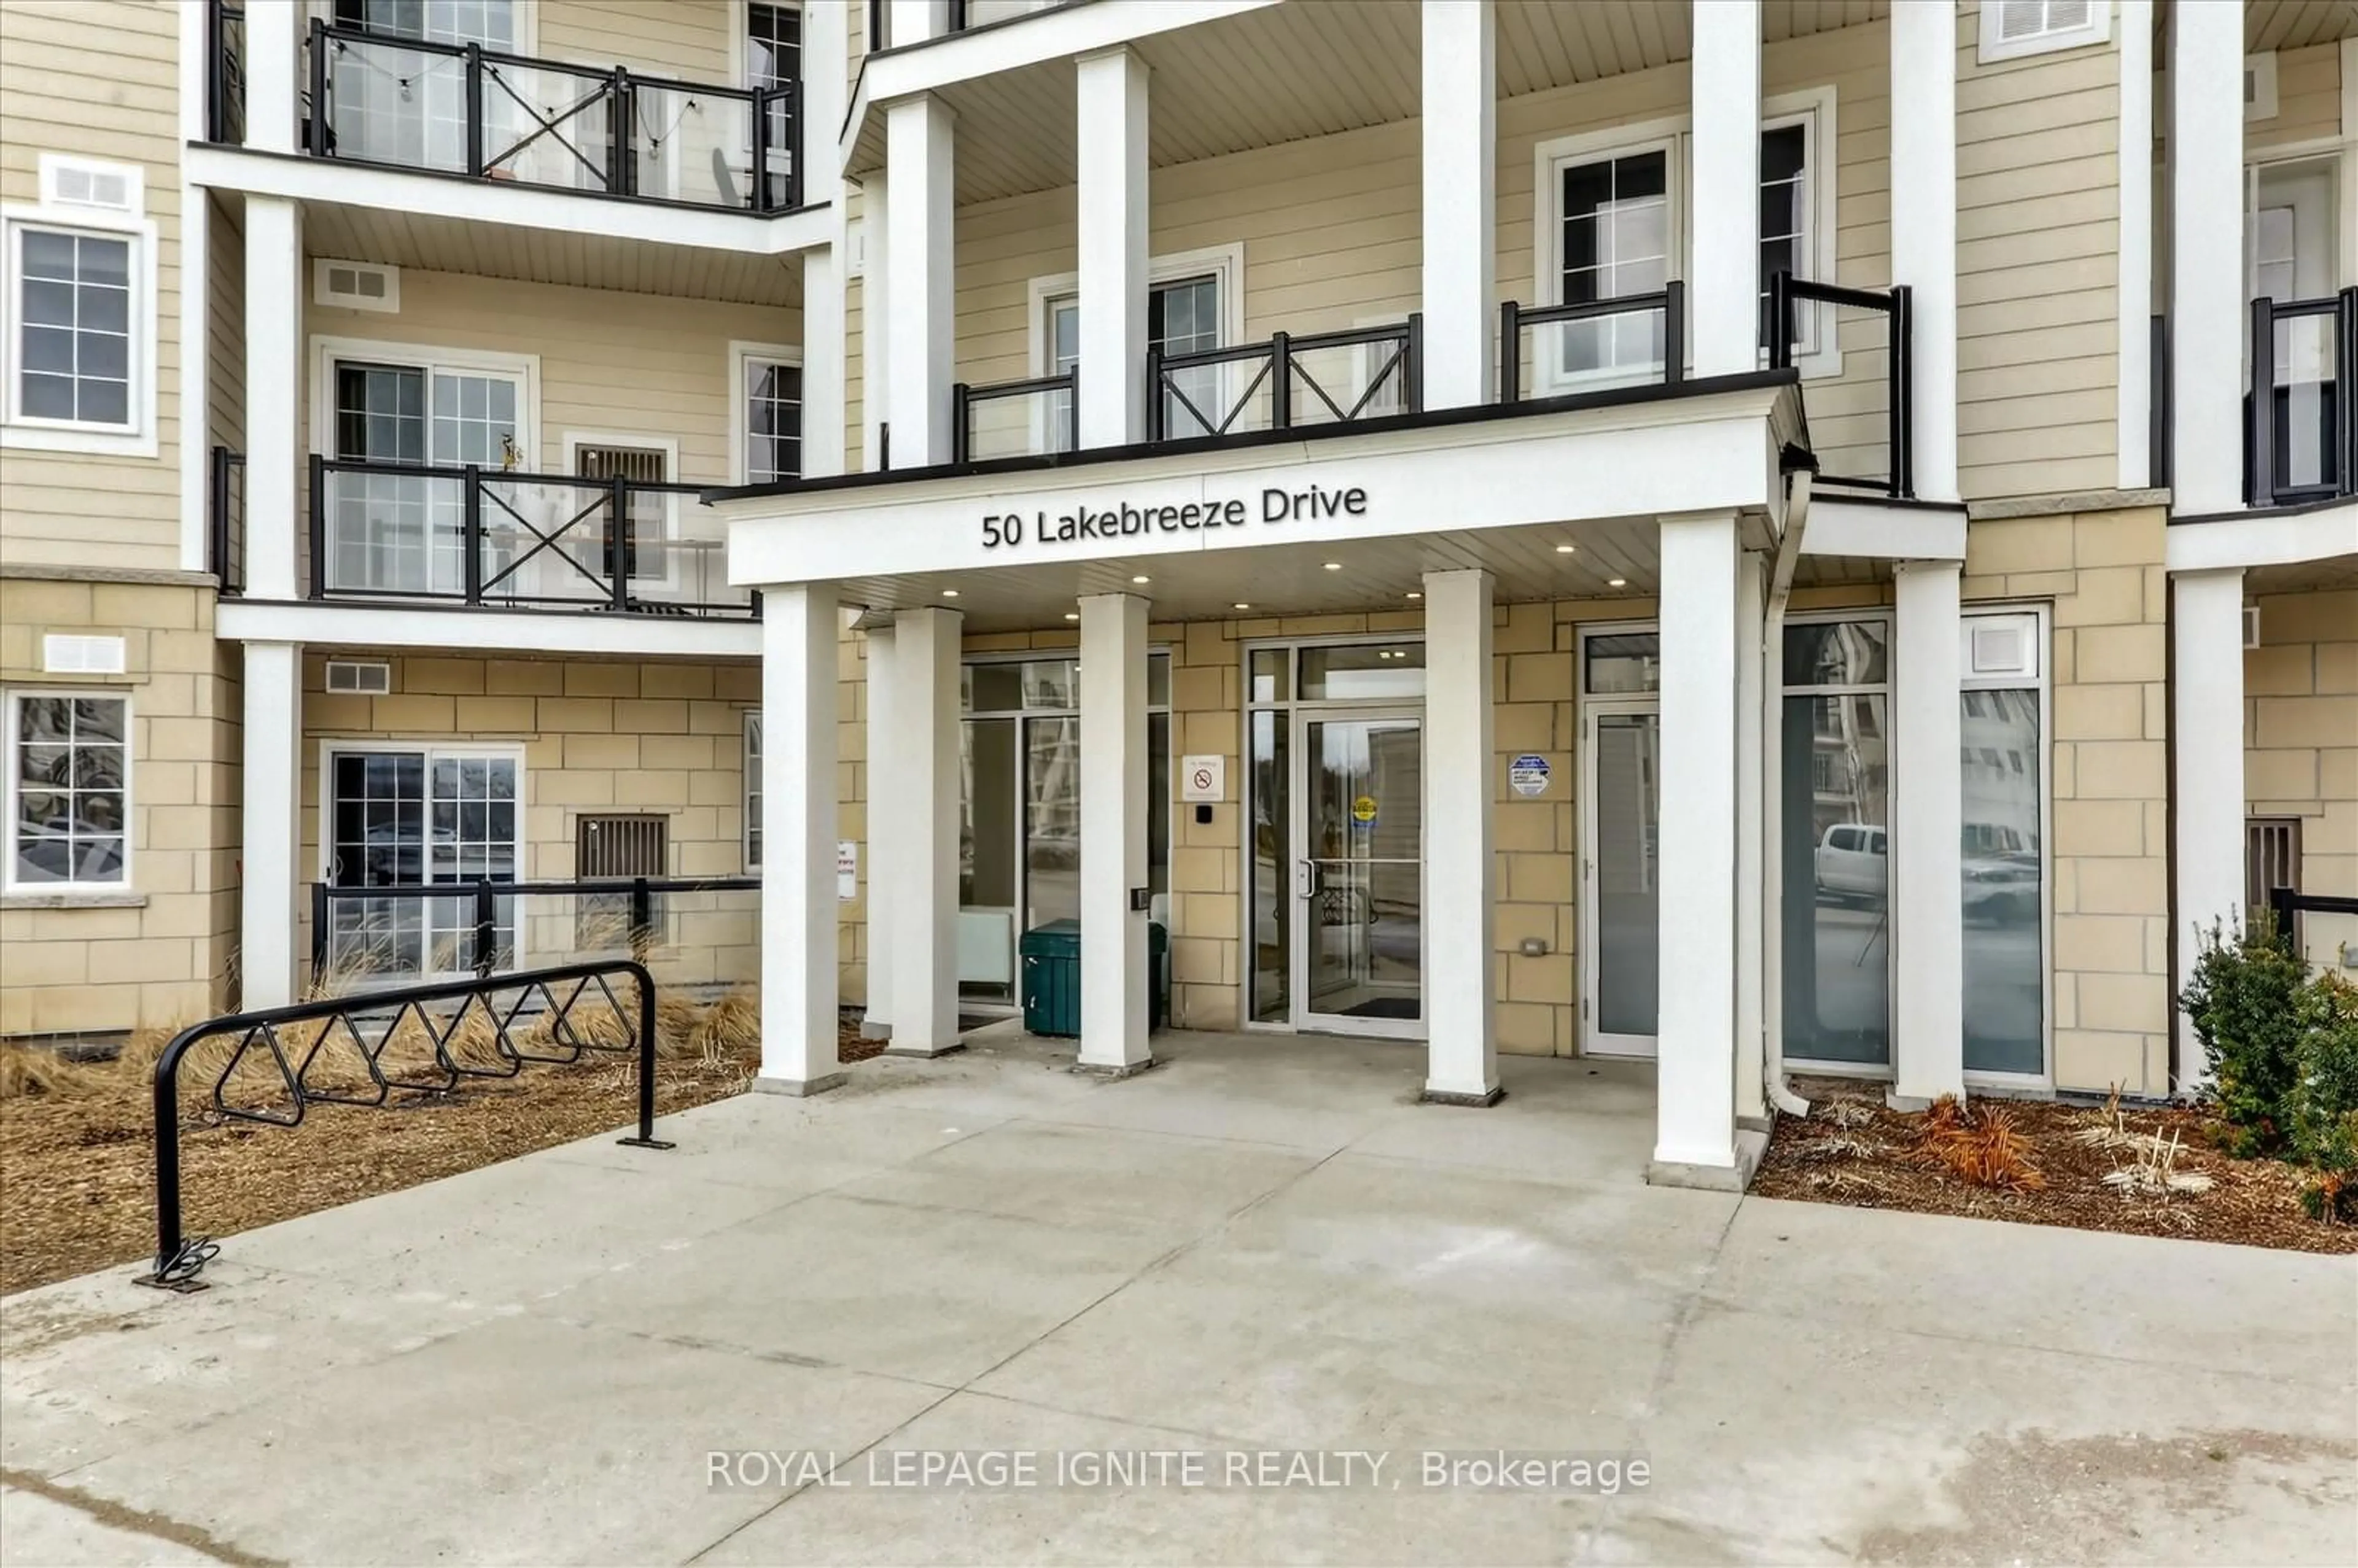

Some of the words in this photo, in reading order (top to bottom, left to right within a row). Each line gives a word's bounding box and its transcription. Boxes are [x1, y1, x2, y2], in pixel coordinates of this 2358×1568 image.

[982, 514, 1022, 548] 50
[1038, 499, 1245, 543] Lakebreeze
[1263, 485, 1367, 523] Drive
